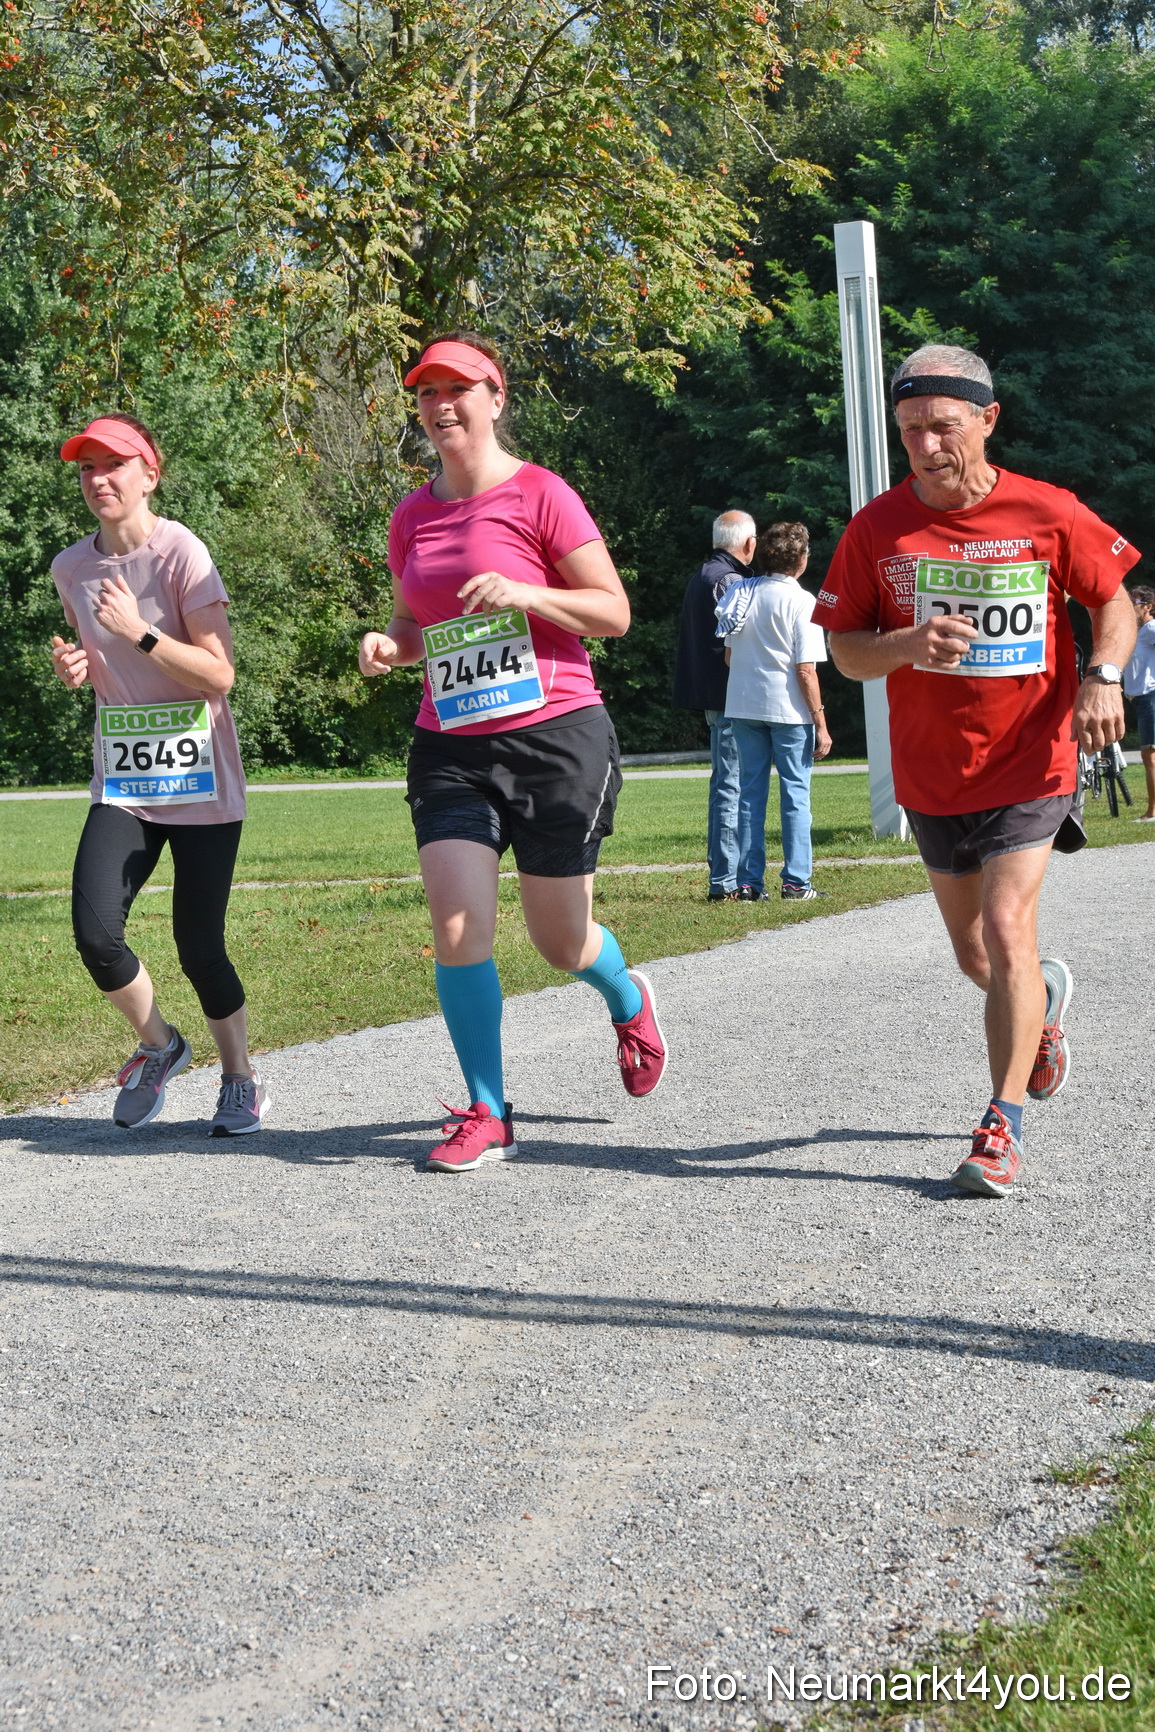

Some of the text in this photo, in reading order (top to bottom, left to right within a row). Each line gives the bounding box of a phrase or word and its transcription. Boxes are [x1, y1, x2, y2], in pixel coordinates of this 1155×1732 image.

[949, 539, 1033, 553] 11. NEUMARKTER
[962, 548, 1020, 560] STADTLAUF
[886, 572, 916, 583] WIEDE
[926, 564, 1038, 595] BOCK
[818, 589, 838, 604] ERER
[896, 597, 915, 605] MARK
[428, 610, 520, 654] BOCK
[960, 646, 1027, 664] RBERT
[437, 645, 523, 692] 2444
[456, 688, 510, 713] KARIN
[105, 705, 201, 733] BOCK
[112, 738, 199, 772] 2649
[119, 777, 199, 795] STEFANIE
